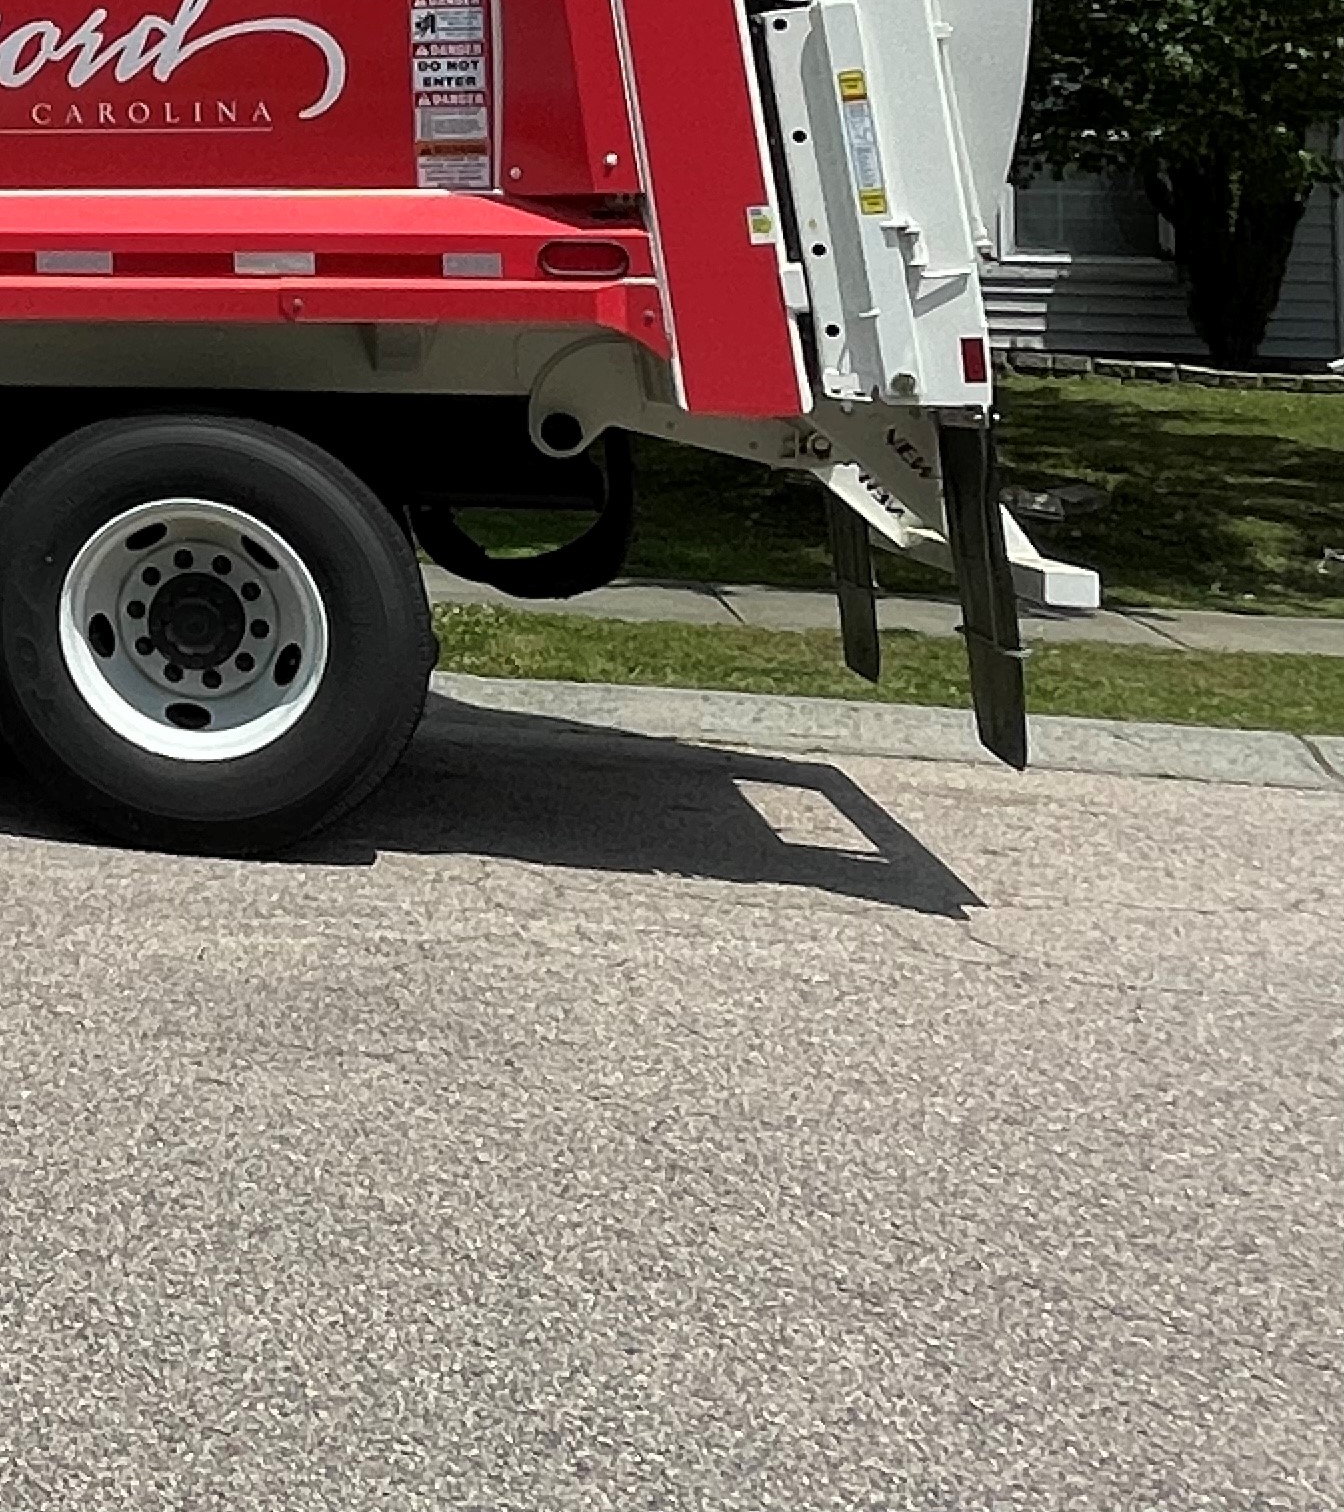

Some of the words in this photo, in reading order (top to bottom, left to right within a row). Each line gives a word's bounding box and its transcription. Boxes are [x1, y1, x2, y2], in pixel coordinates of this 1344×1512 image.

[418, 60, 442, 72] DO
[446, 60, 480, 72] NOT
[422, 76, 476, 88] ENTER
[31, 101, 274, 125] CAROLINA
